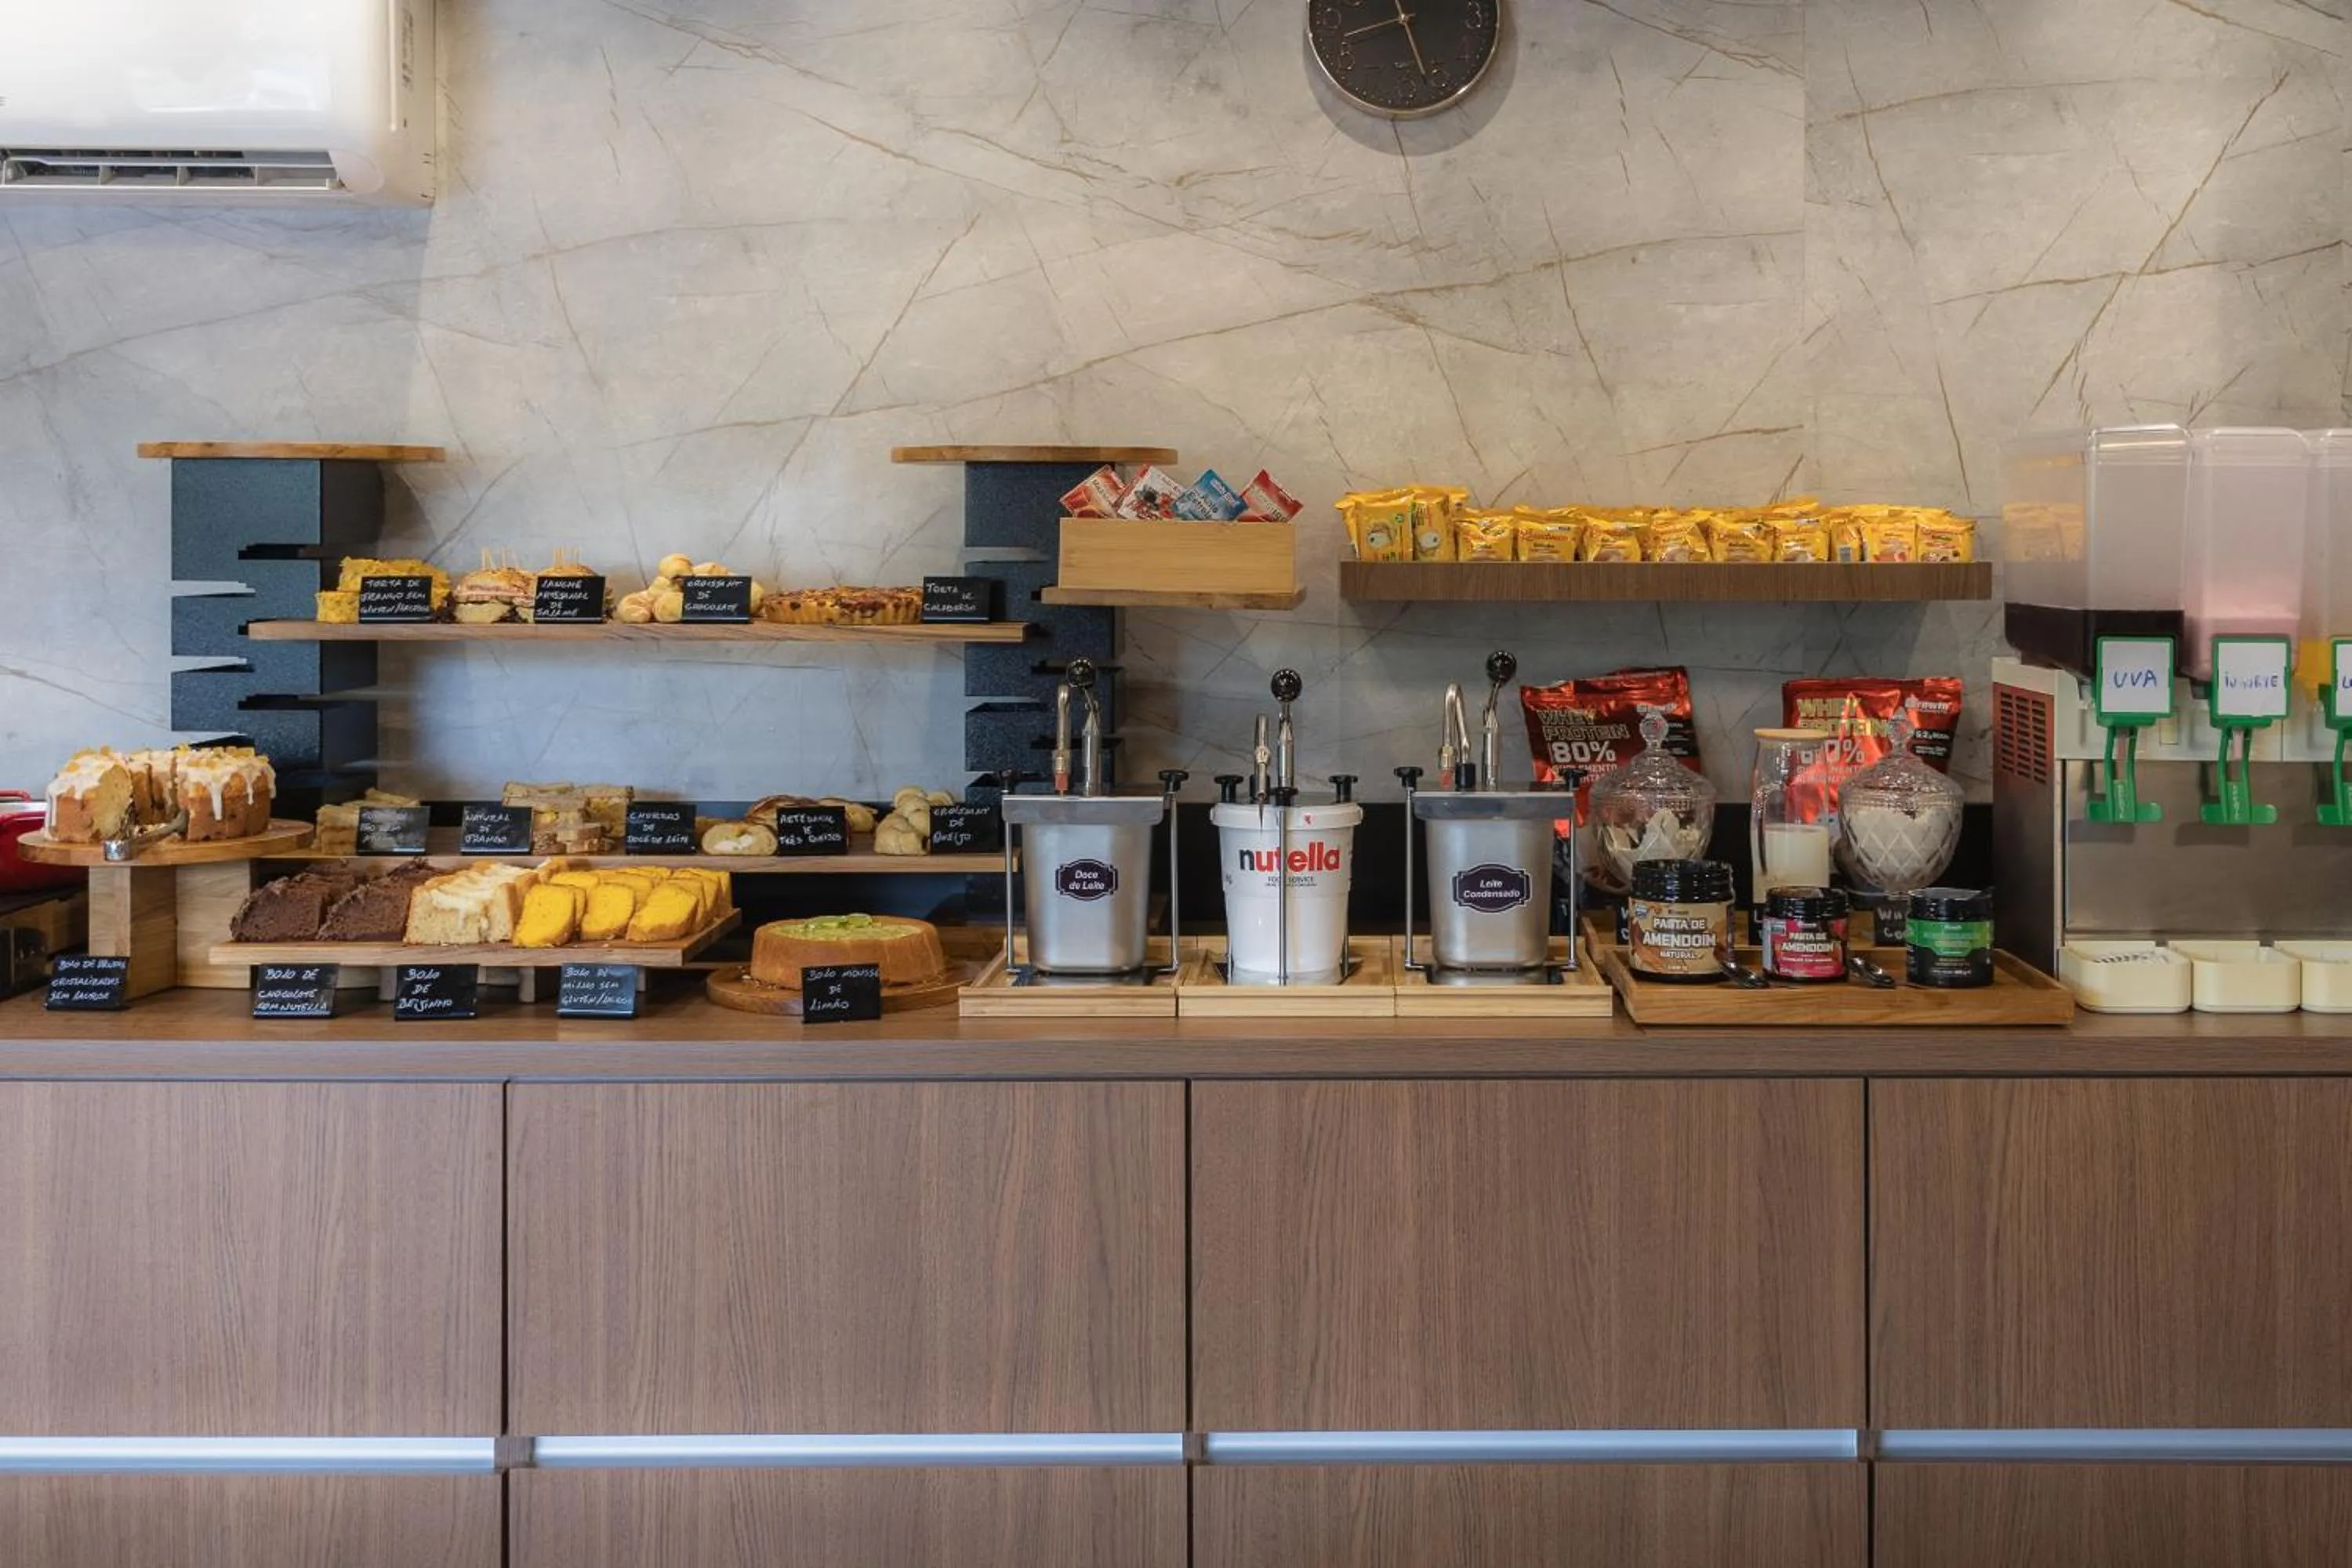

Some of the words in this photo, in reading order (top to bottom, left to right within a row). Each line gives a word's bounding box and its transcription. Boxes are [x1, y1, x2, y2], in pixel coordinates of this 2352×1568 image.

[2113, 669, 2157, 688] UVA
[1552, 740, 1617, 764] 80%
[1075, 869, 1098, 879] Doce
[1069, 881, 1080, 890] de
[1082, 880, 1105, 890] Leite
[1479, 879, 1503, 888] Leite
[1653, 917, 1689, 930] PASTA
[1691, 919, 1706, 930] DE
[1642, 932, 1717, 947] AMENDOIM
